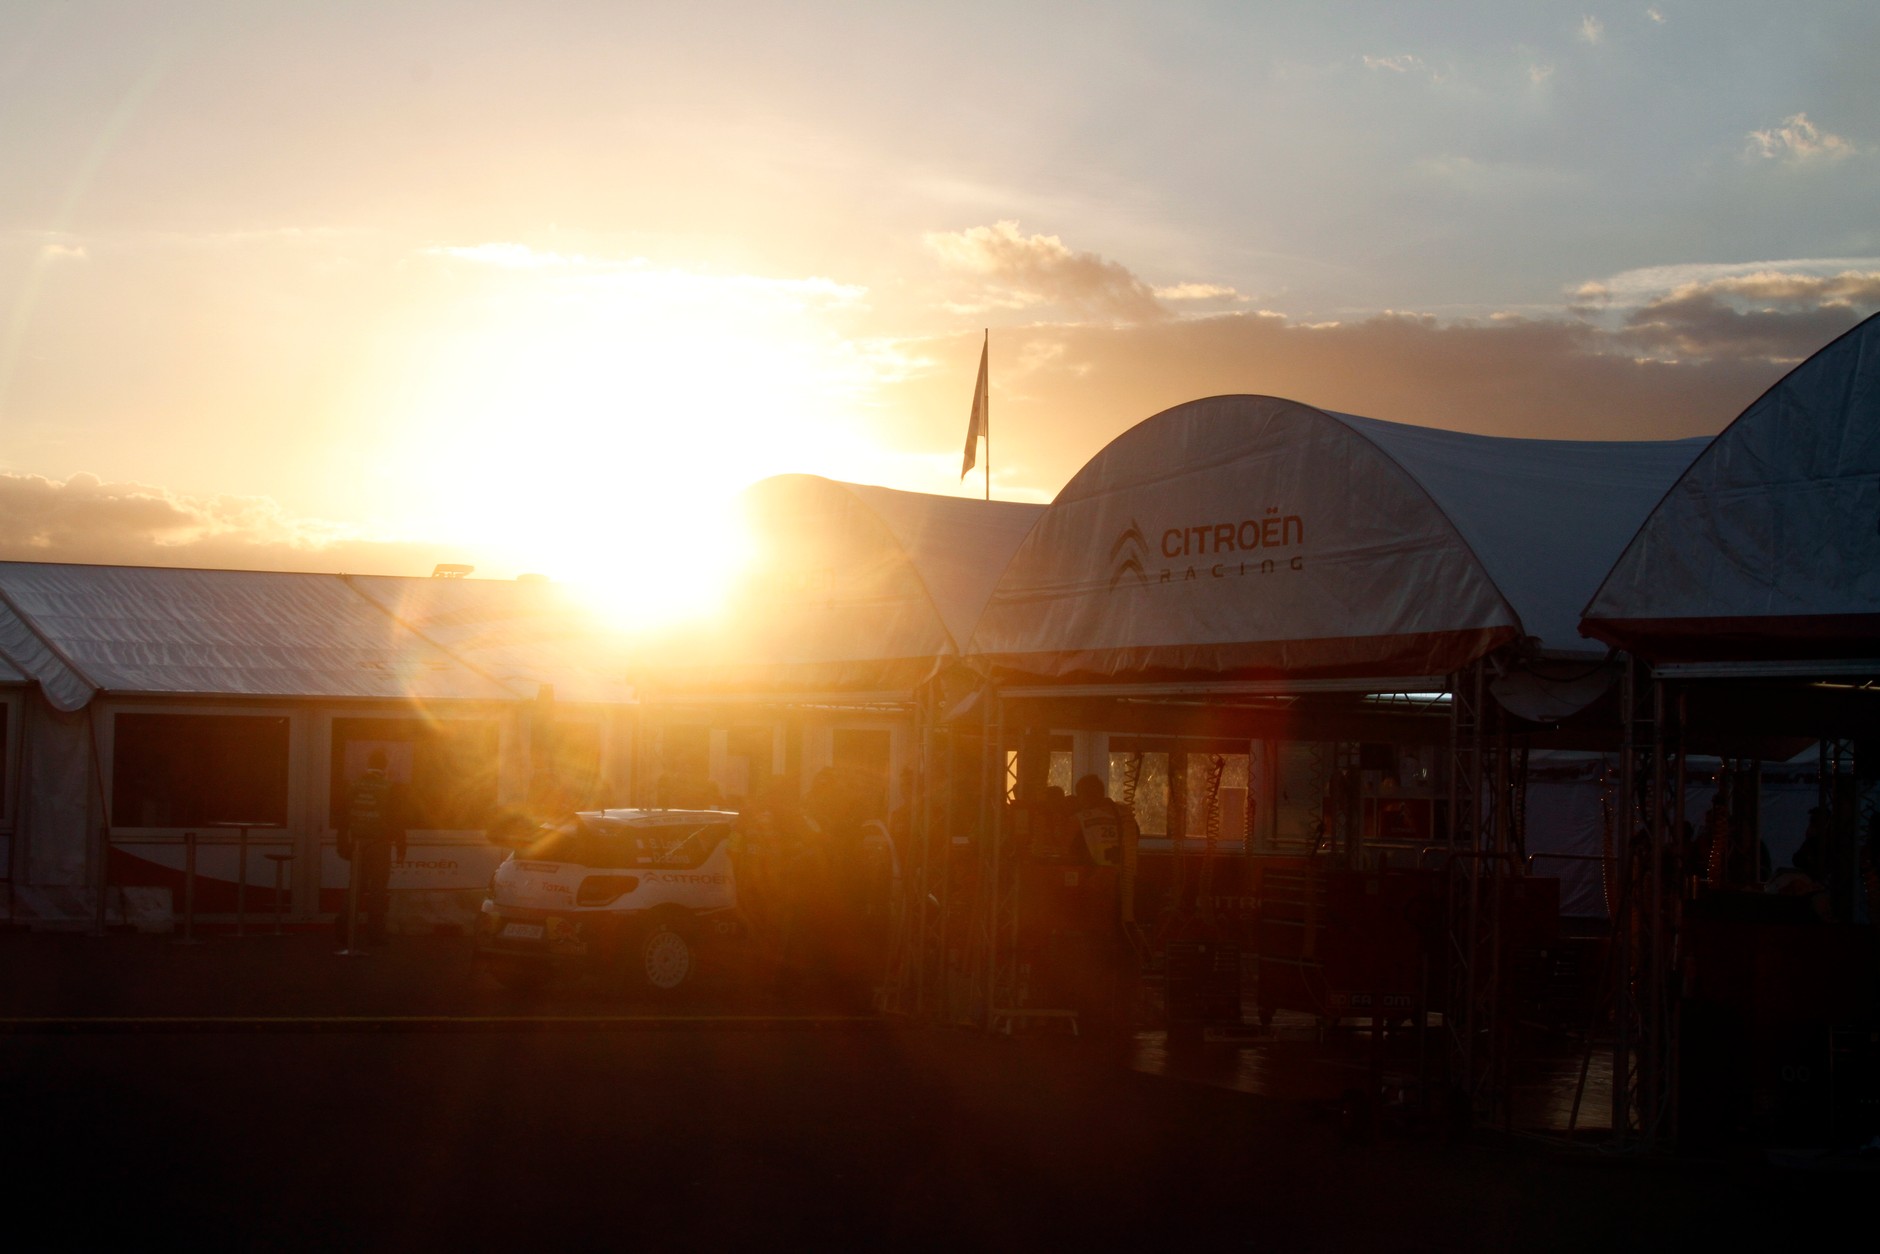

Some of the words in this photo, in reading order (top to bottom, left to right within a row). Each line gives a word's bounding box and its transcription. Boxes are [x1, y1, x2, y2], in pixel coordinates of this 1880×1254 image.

[1161, 507, 1303, 558] CITROËN
[1159, 556, 1303, 583] RACING
[1100, 826, 1115, 838] 26
[542, 881, 573, 894] TOTAL
[1351, 994, 1412, 1007] FAOM
